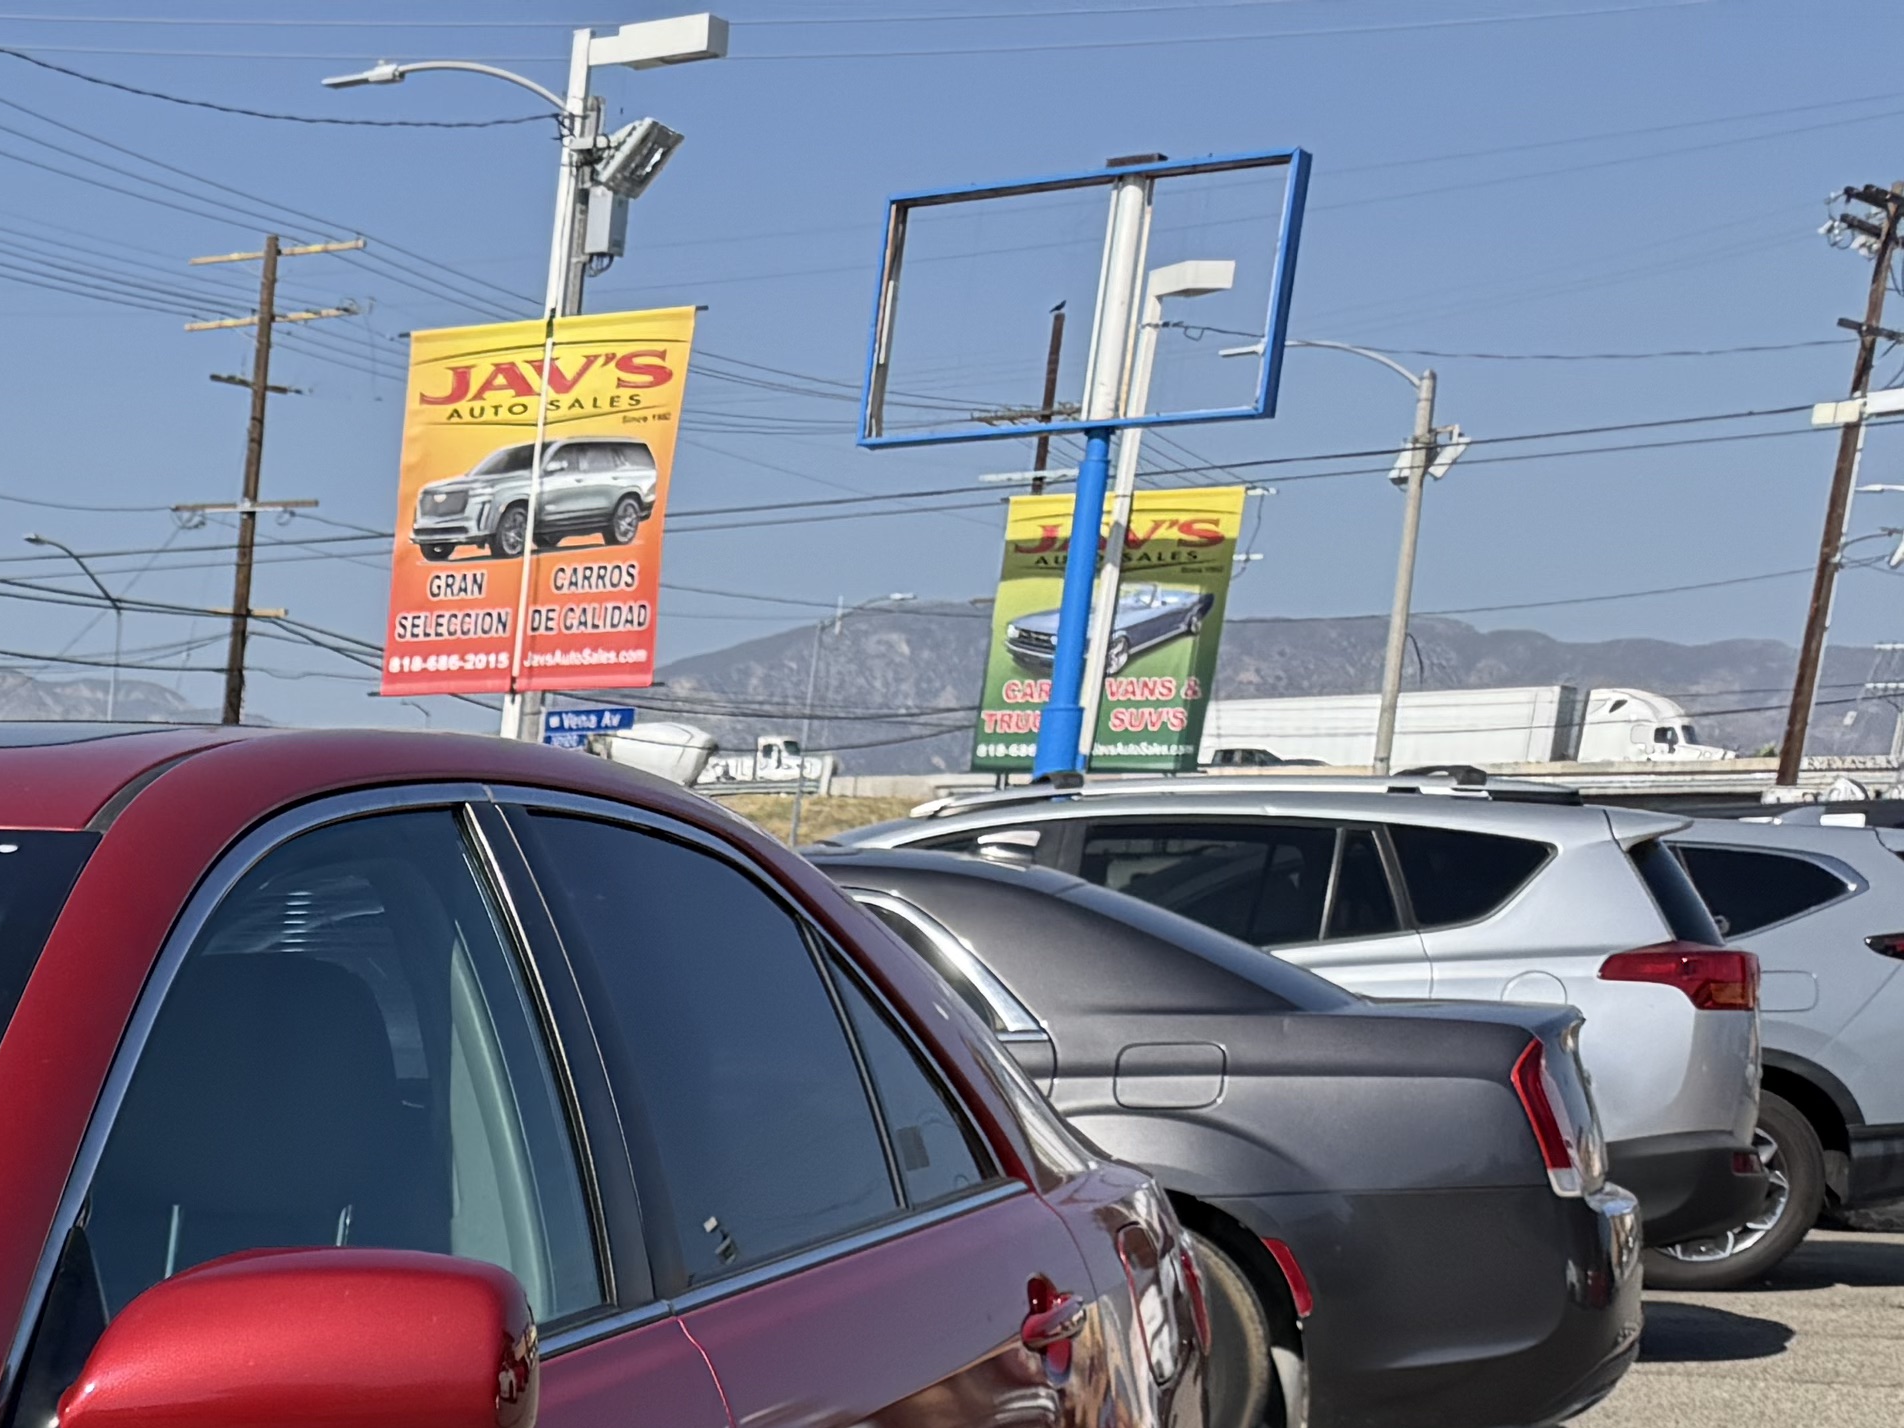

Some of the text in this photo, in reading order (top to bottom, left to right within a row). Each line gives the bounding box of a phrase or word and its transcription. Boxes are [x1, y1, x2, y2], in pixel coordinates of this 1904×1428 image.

[419, 348, 673, 406] JAV'S
[447, 394, 642, 422] AUTO SALES
[1015, 518, 1225, 554] JV'S
[429, 571, 486, 599] GRAN
[552, 563, 639, 593] CARROS
[396, 610, 511, 641] SELECCION
[530, 603, 649, 634] DE CALIDAD
[1105, 677, 1202, 701] VANS &
[1110, 708, 1187, 732] SUV'S
